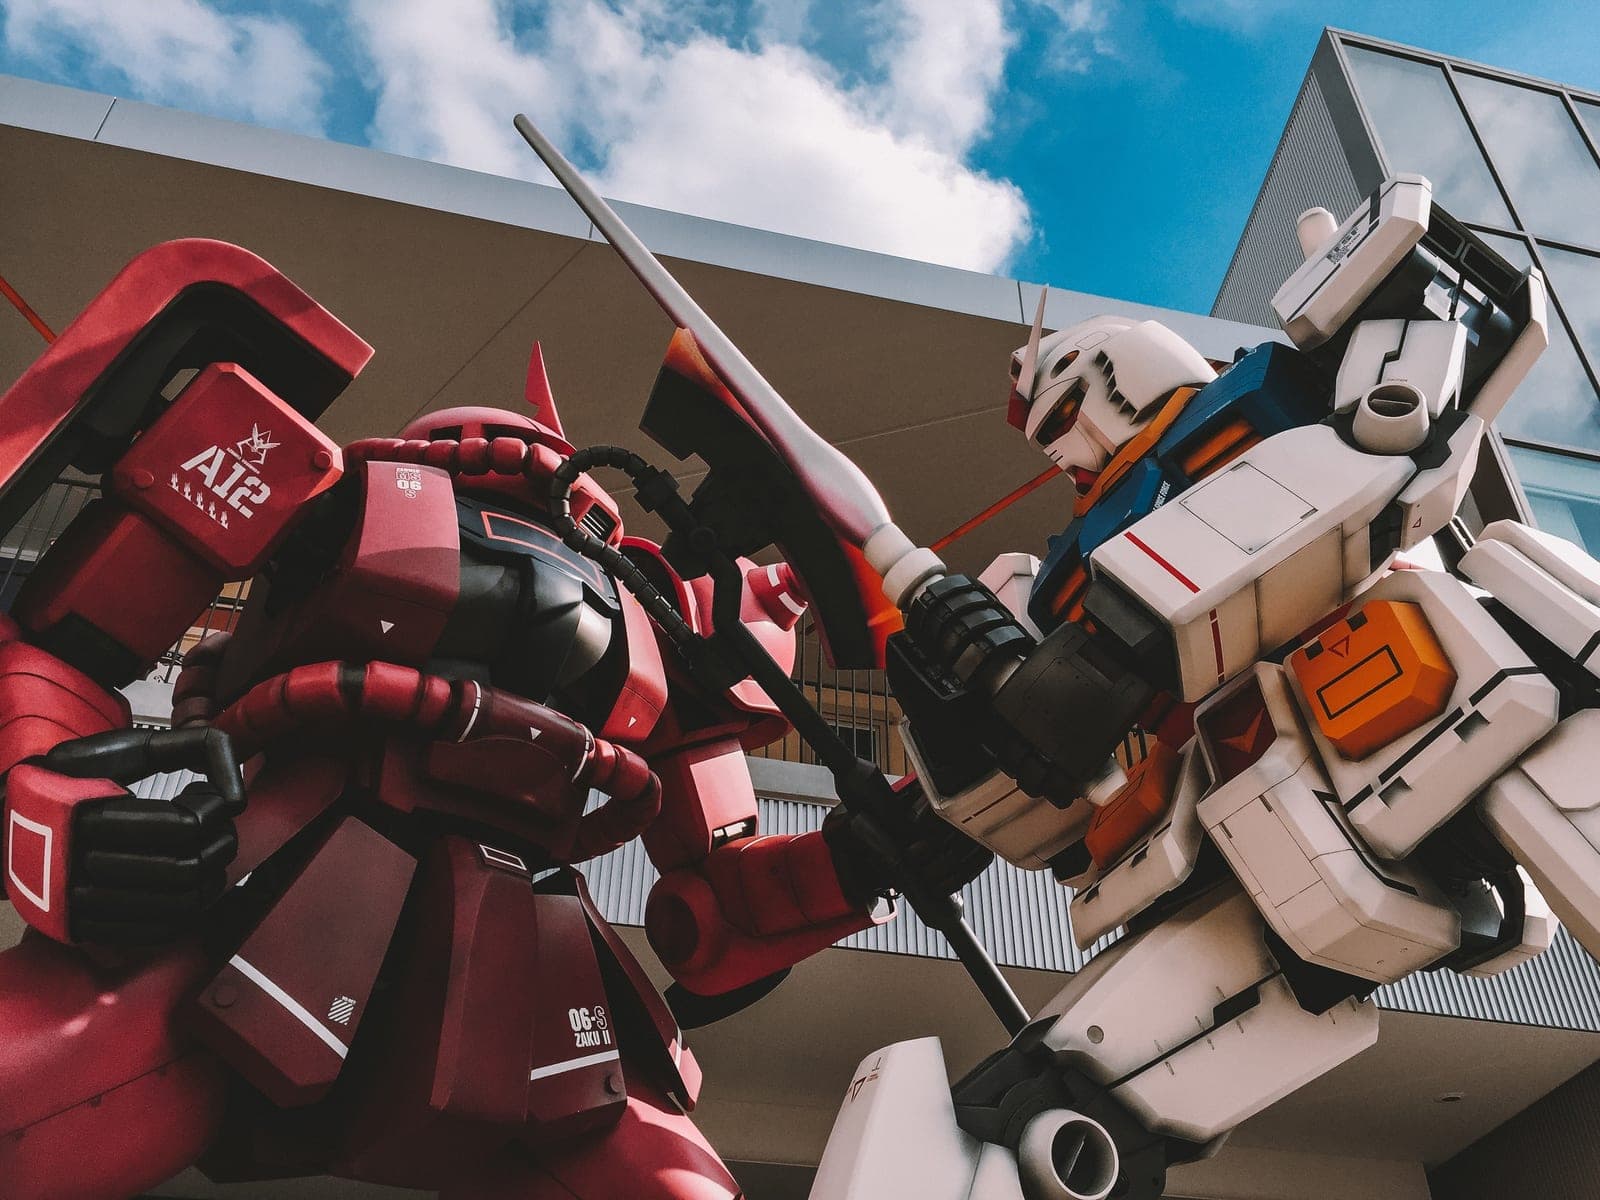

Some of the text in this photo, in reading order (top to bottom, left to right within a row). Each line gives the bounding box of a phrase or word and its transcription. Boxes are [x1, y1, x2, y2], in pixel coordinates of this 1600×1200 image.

[181, 445, 271, 519] A12
[396, 479, 422, 490] 06
[405, 489, 416, 499] S
[568, 1005, 608, 1031] 06-S
[574, 1030, 601, 1047] ZAKU
